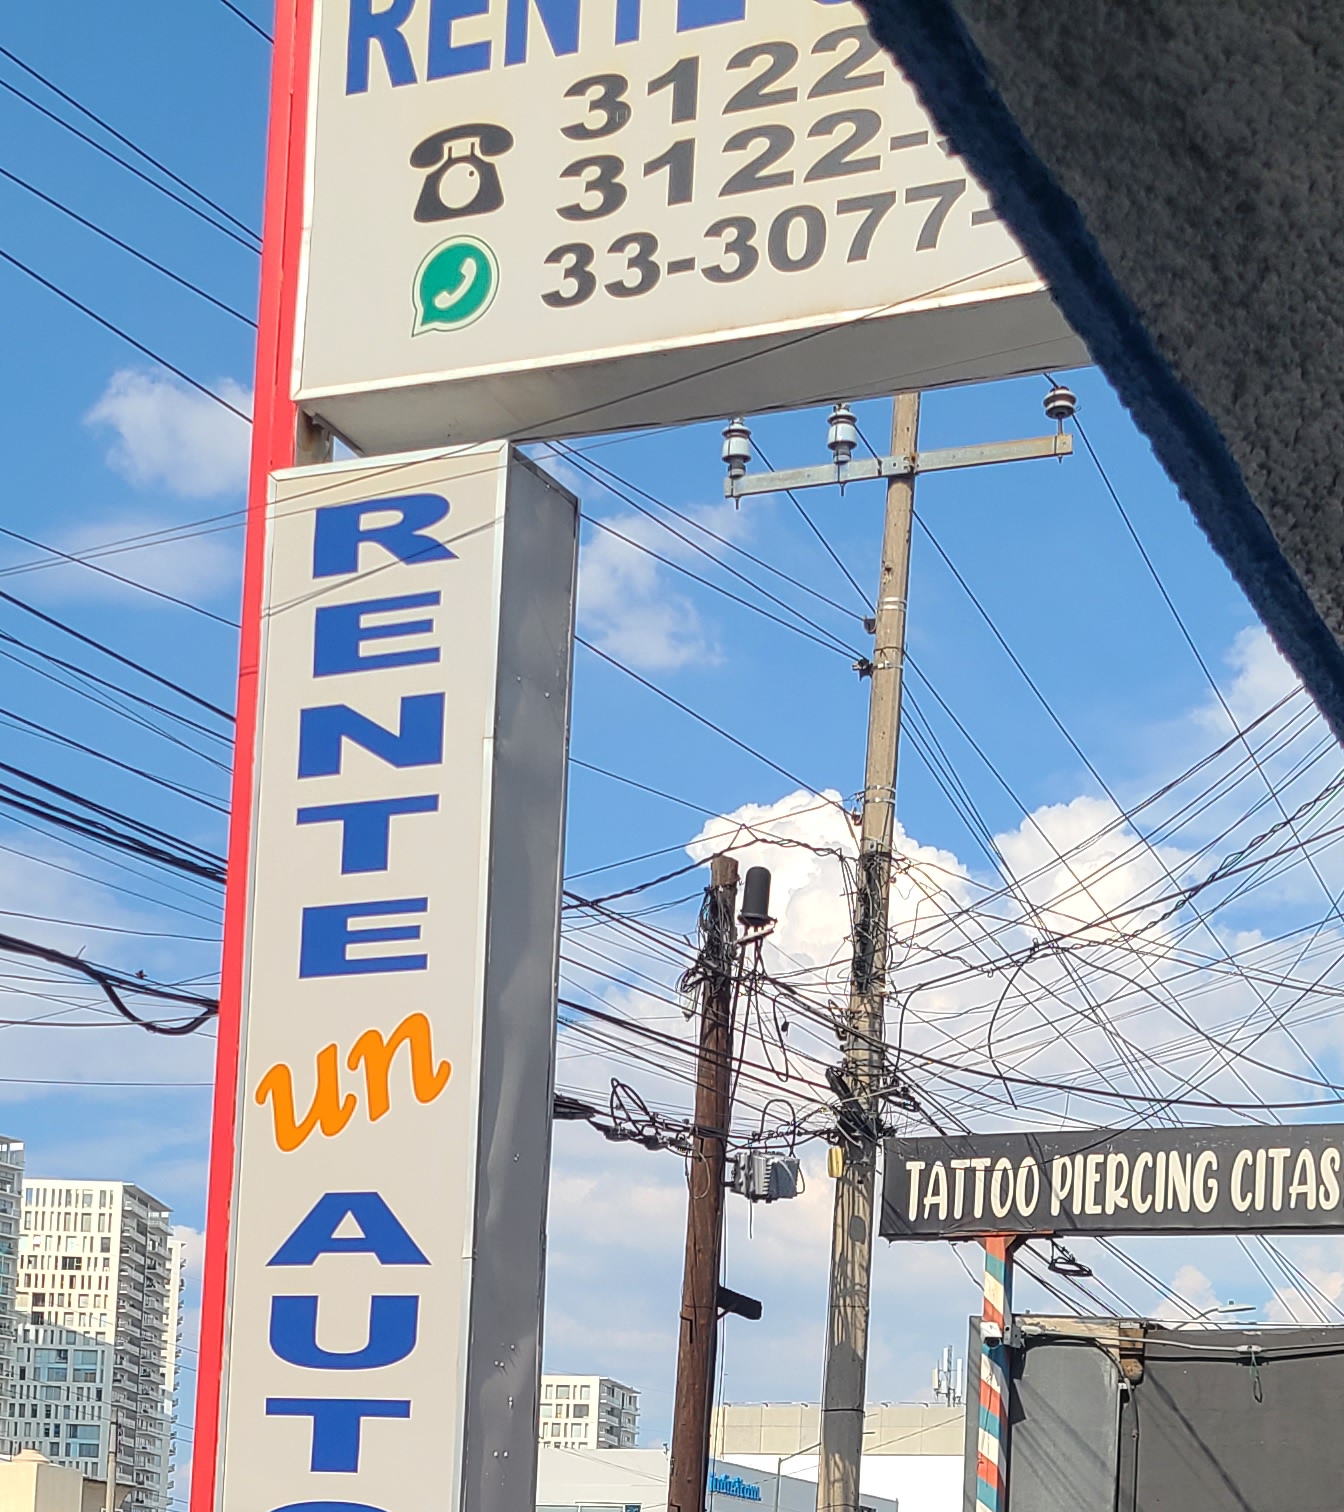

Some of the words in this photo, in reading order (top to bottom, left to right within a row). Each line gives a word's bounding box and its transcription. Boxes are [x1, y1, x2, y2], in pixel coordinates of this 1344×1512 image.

[556, 108, 951, 222] 3122-
[296, 492, 460, 980] RENTE
[254, 1011, 453, 1153] un
[906, 1156, 1040, 1222] TATTOO
[1051, 1149, 1219, 1217] PIERCING
